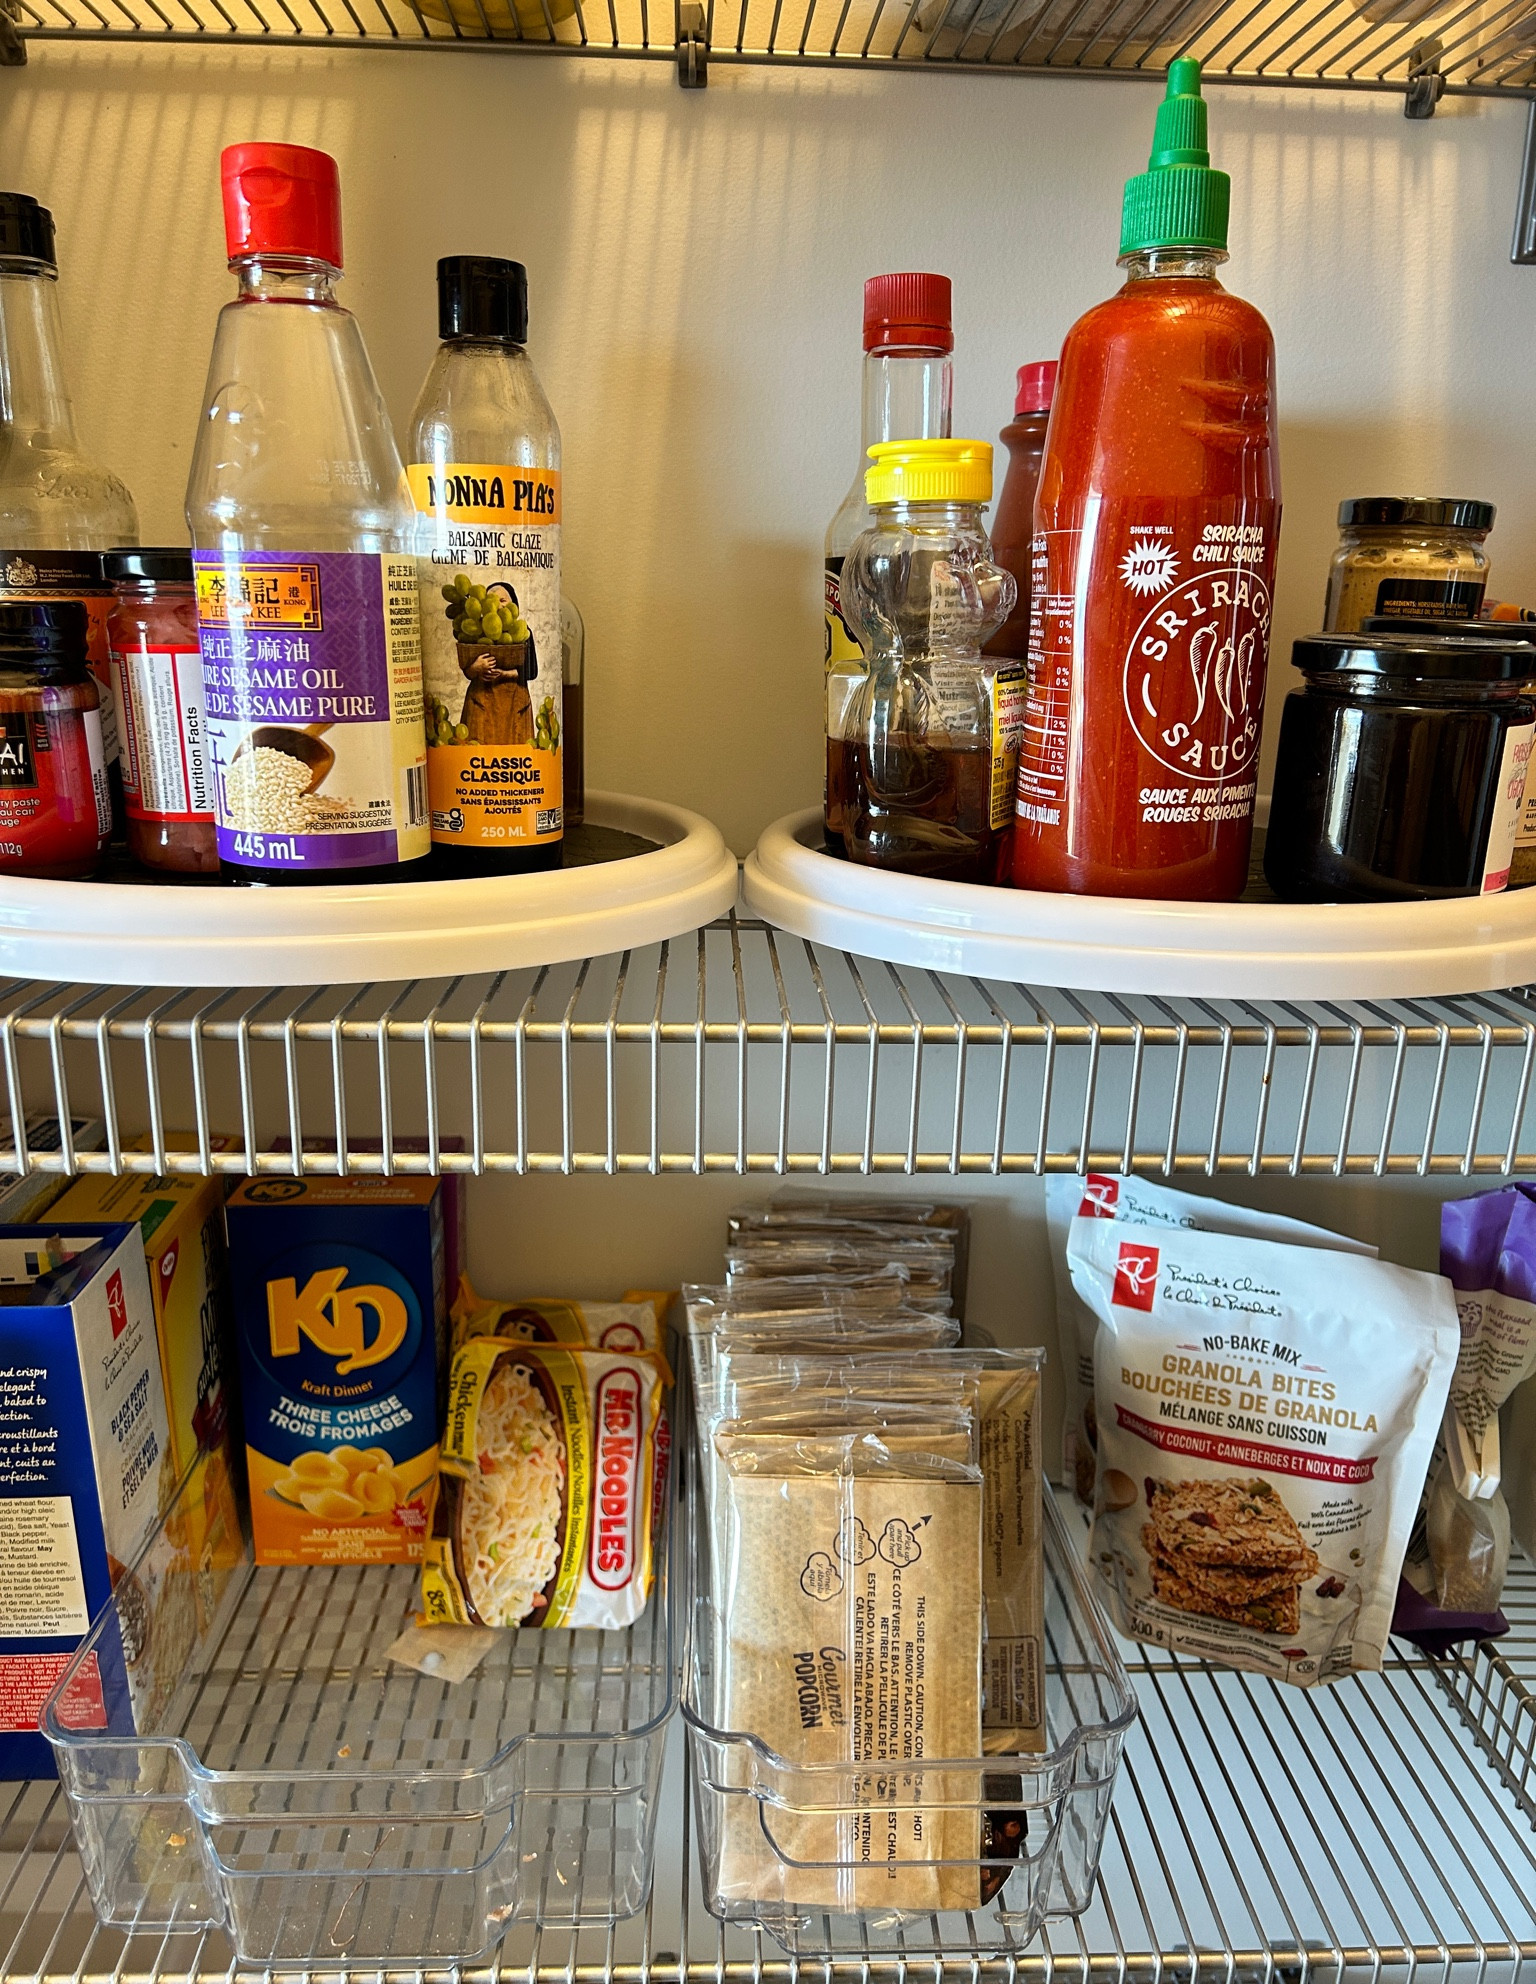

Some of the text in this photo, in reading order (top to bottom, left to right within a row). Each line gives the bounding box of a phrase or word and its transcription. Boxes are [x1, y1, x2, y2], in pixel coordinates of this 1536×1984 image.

[427, 475, 555, 514] NONNA PIA'S
[448, 530, 542, 550] BALSAMIC GLAZE
[1130, 526, 1173, 535] SHAKE WELL
[1202, 524, 1263, 544] SRIRACHA
[474, 550, 490, 566] DE
[496, 551, 554, 569] BALSAMIQUE
[1192, 545, 1265, 563] CHILI SAUCE
[1131, 558, 1169, 576] HOT
[257, 606, 282, 619] KEE
[222, 667, 298, 689] SESAME
[302, 668, 344, 690] OIL
[212, 689, 376, 718] DE SÉSAME PURE
[997, 697, 1013, 709] liquid
[1161, 716, 1258, 771] SAUCE
[187, 706, 207, 809] Nutrition Facts
[470, 756, 533, 770] CLASSIC
[460, 769, 541, 785] CLASSIQUE
[12, 798, 40, 808] paste
[455, 787, 545, 797] NO ADDED THICKENERS
[460, 797, 542, 807] SANS ÉPAISSISSANTS
[1138, 782, 1256, 805] SAUCE AUX PIMENTS
[15, 807, 35, 816] cari
[317, 812, 349, 821] SERVING
[484, 805, 522, 815] AJOUTÉS
[1142, 802, 1250, 823] ROUGES SRIRACHA
[305, 818, 392, 830] PRÉSENTATION SUGGÉRÉE
[481, 826, 527, 838] 250 ML
[234, 834, 305, 861] 445 mL
[267, 1265, 408, 1377] KD
[1202, 1335, 1303, 1367] NO-BAKE MIX
[16, 1367, 47, 1380] crispy
[1161, 1353, 1337, 1402] GRANOLA BITES
[0, 1380, 36, 1396] elegant
[301, 1379, 374, 1398] Kraft Dinner
[4, 1394, 47, 1406] baked to
[111, 1368, 150, 1435] BLACK PEPPER
[123, 1388, 148, 1434] SEA SALT
[278, 1394, 403, 1425] THREE CHEESE
[454, 1371, 478, 1430] Chicken
[561, 1384, 580, 1425] Instant
[1120, 1366, 1232, 1412] BOUCHÉES
[1239, 1391, 1268, 1413] DE
[1275, 1398, 1379, 1434] GRANOLA
[121, 1407, 149, 1453] CRACKERS
[268, 1408, 413, 1440] TROIS FROMAGES
[1159, 1399, 1327, 1447] MÉLANGE SANS CUISSON
[11, 1442, 56, 1453] et bord
[147, 1443, 159, 1470] MER
[1023, 1433, 1032, 1470] Artificial
[1121, 1414, 1370, 1478] CRANBERRY COCONUT CANNEBERGES ET NOIX DE COCO
[15, 1456, 56, 1467] cuits au
[122, 1431, 156, 1492] POIVRE NOIR
[598, 1387, 635, 1573] MR. NOODLES
[1321, 1500, 1340, 1509] Made
[1325, 1507, 1353, 1518] Canadian
[331, 1527, 387, 1536] ARTIFICIAL
[1015, 1495, 1024, 1546] Preservatives
[1315, 1526, 1345, 1537] canadiens
[37, 1545, 53, 1553] May
[321, 1551, 383, 1560] ARTIFICIELS
[42, 1575, 76, 1583] tournesol
[13, 1613, 53, 1621] Substances
[854, 1596, 865, 1686] CALIENTE! RETIRE
[864, 1572, 876, 1720] ESTE LADO HACIA ABAJO.
[1155, 1629, 1164, 1641] g
[889, 1568, 902, 1741] CE CÔTÉ ATTENTION,
[914, 1596, 925, 1733] THIS SIDE DOWN. CAUTION,
[878, 1617, 889, 1730] RETIRER PELLICULE
[904, 1641, 914, 1728] REMOVE PLASTIC
[1015, 1643, 1024, 1722] This Side Down
[793, 1651, 823, 1730] POPCORN
[816, 1664, 827, 1712] MICROWAVE
[819, 1646, 849, 1729] Gourmet
[888, 1812, 896, 1831] EST
[913, 1815, 922, 1841] HOT!
